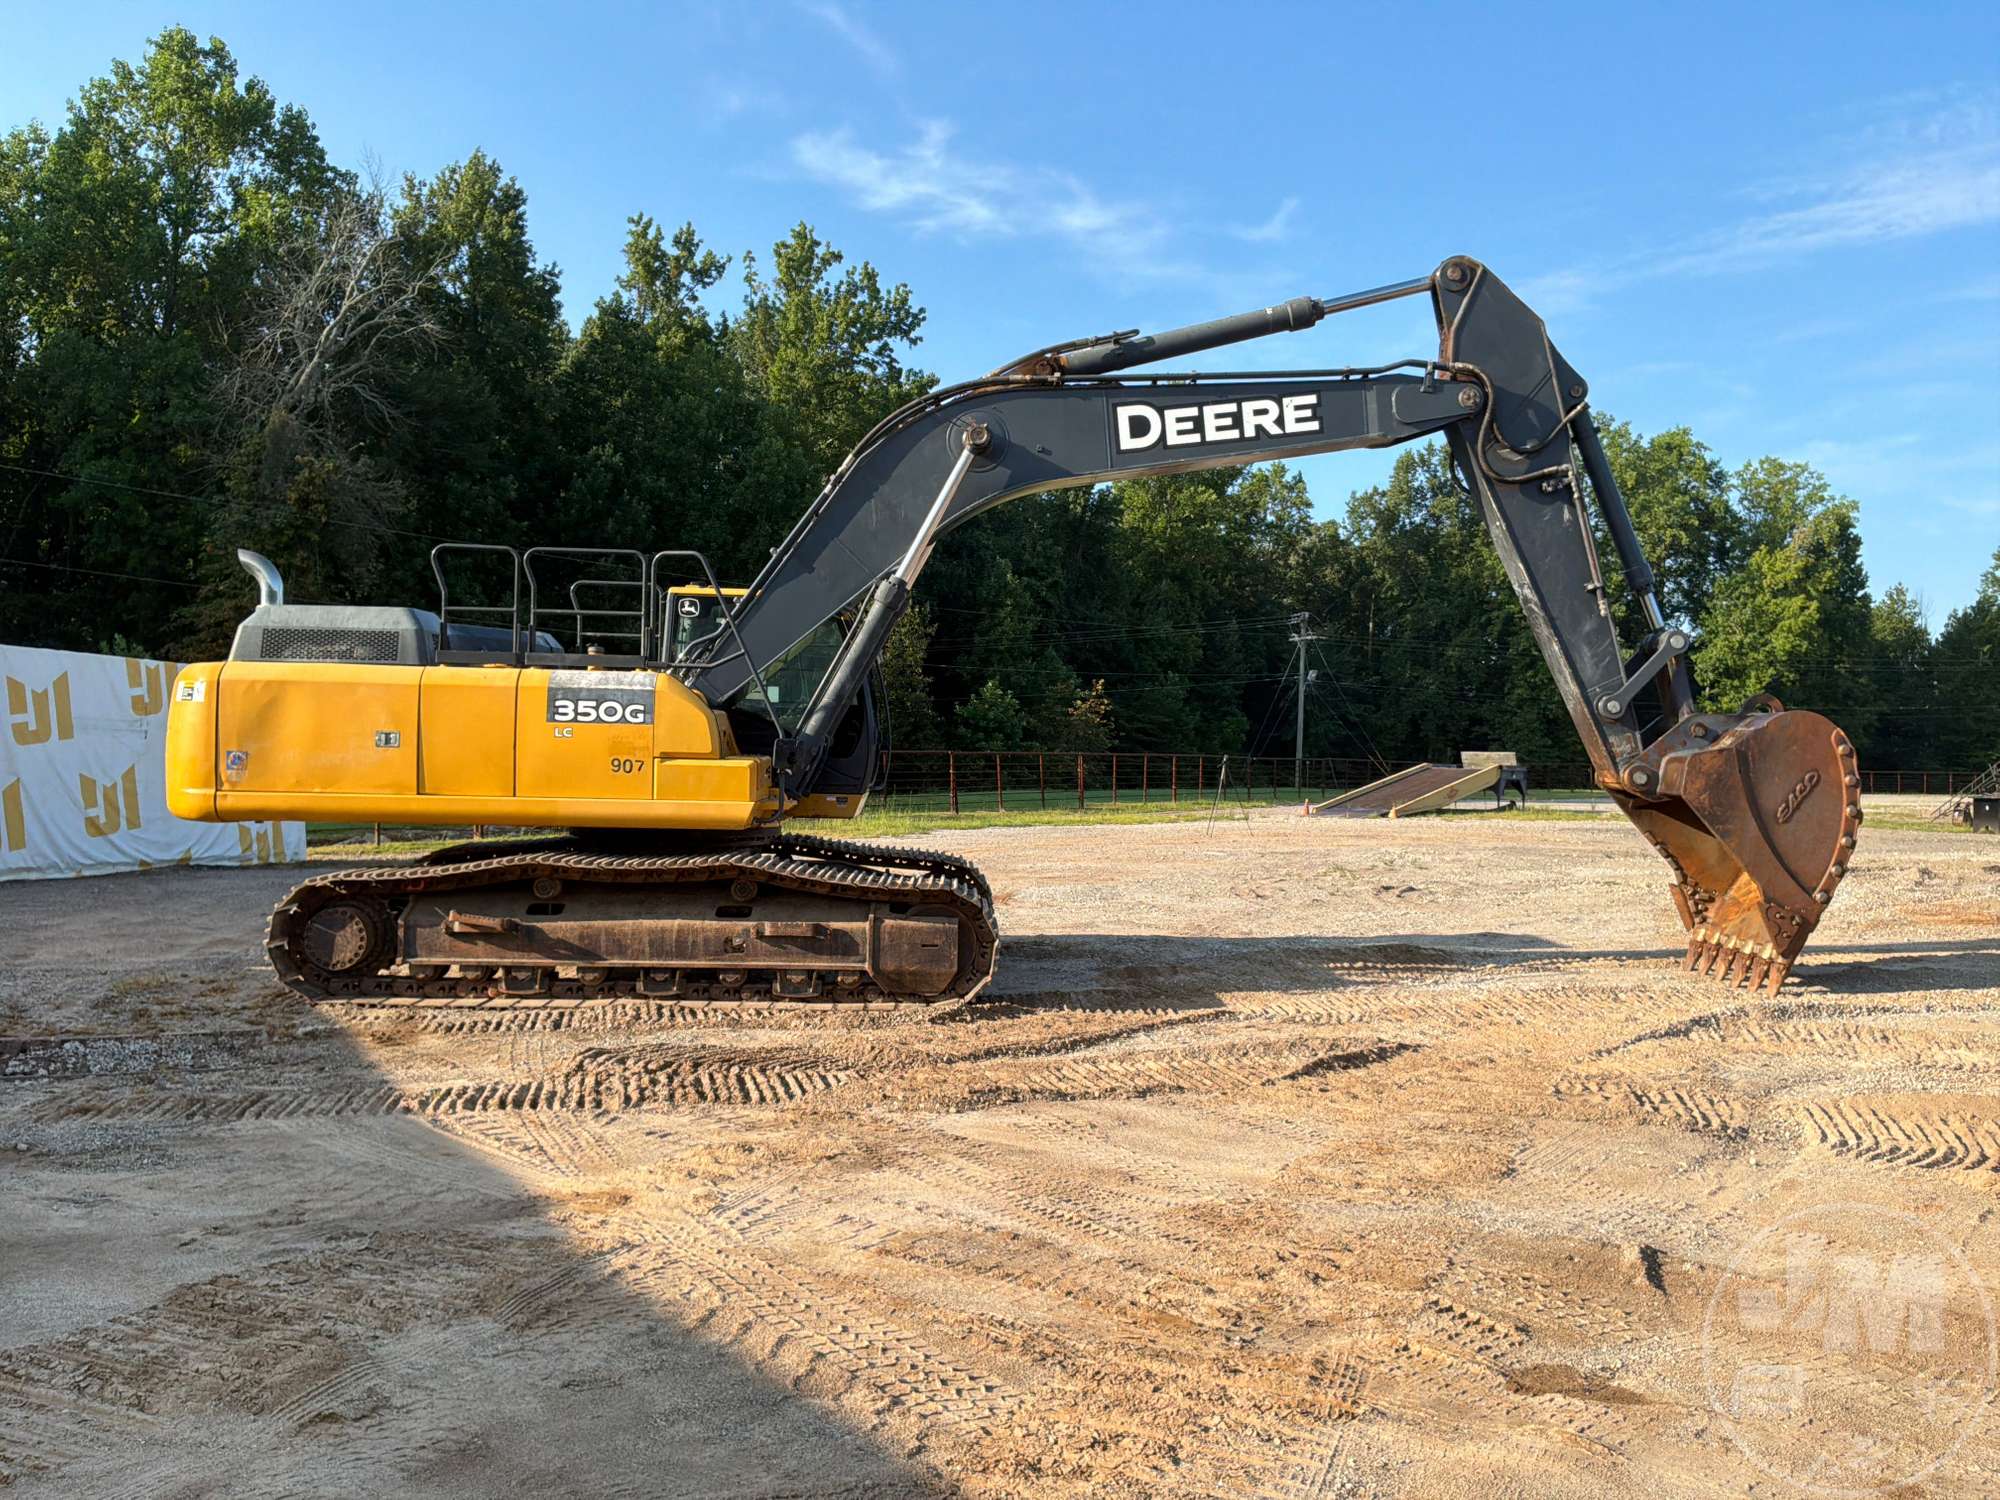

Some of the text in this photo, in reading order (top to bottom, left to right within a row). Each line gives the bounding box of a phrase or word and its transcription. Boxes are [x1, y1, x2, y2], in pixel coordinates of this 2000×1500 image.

[1116, 394, 1320, 450] DEERE
[554, 700, 645, 723] 350G
[554, 727, 573, 737] LC
[611, 758, 645, 773] 907
